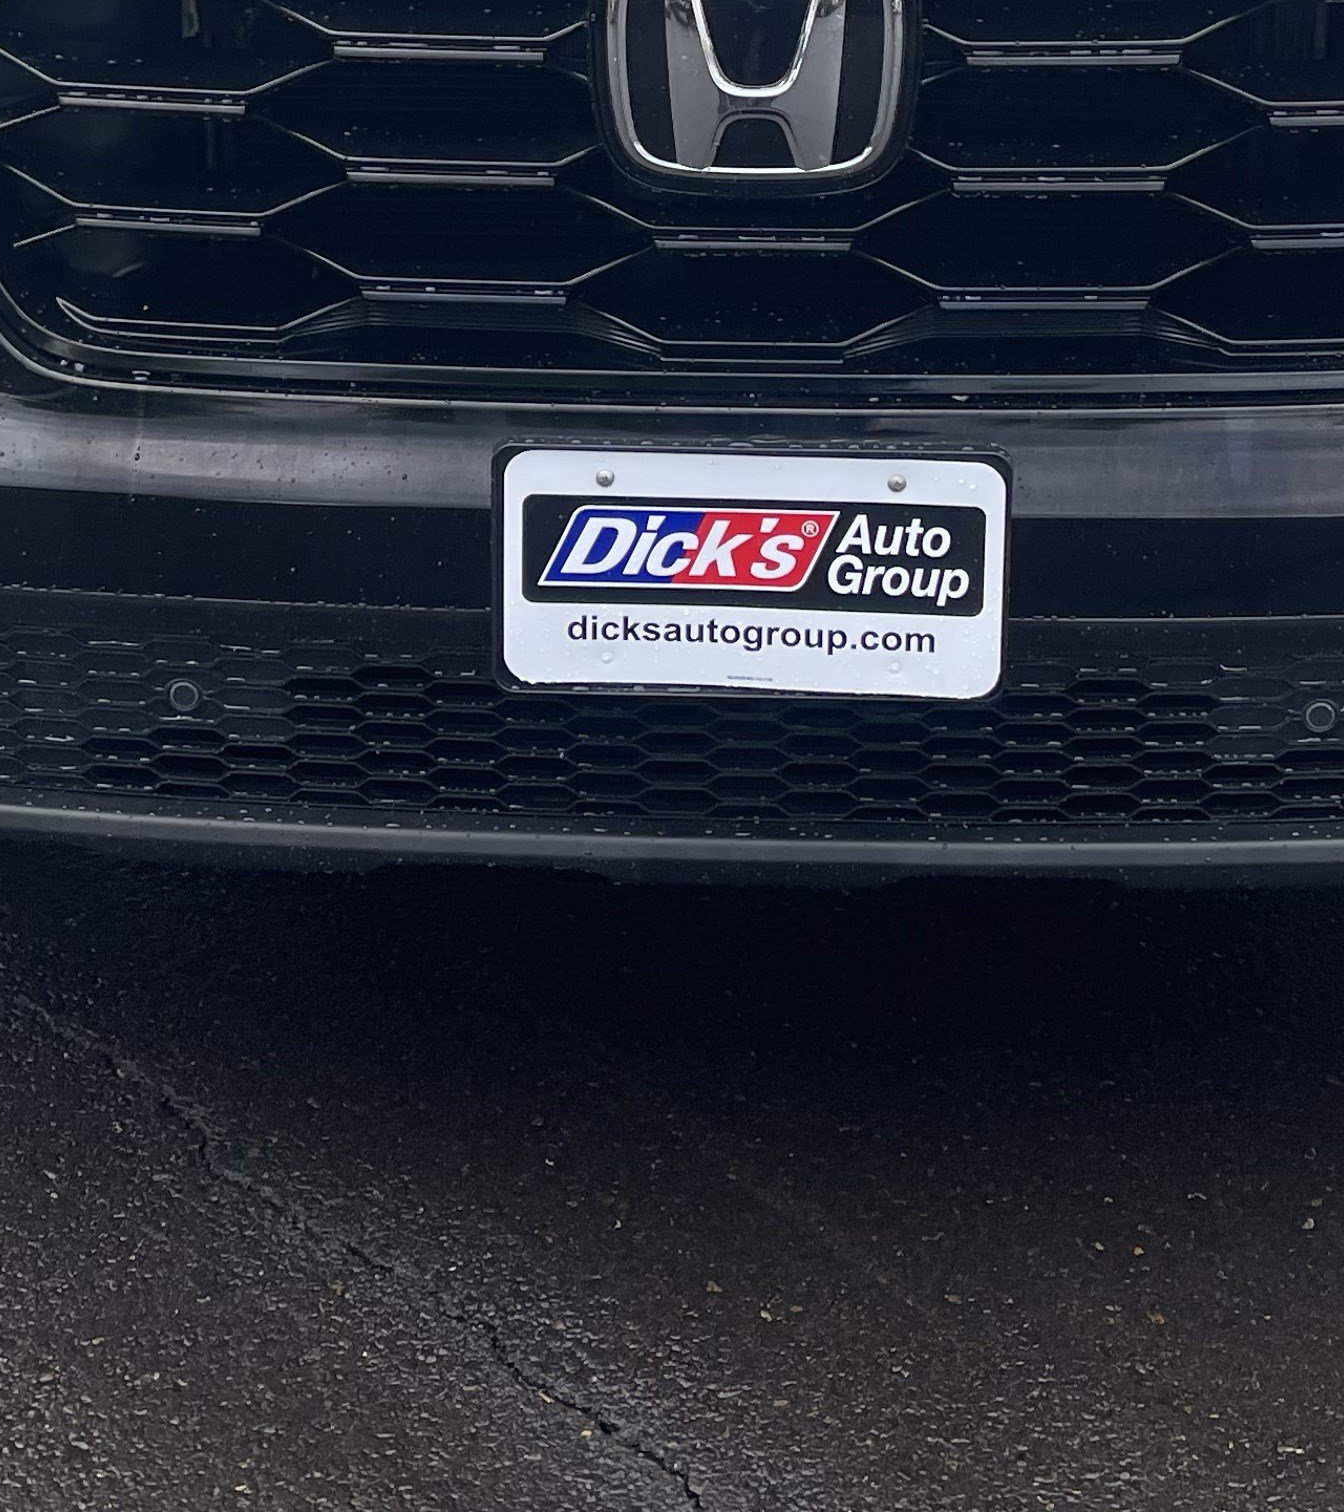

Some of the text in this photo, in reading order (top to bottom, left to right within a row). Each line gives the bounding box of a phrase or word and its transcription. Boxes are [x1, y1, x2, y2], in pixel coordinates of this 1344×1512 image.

[559, 515, 805, 580] Dick's
[835, 513, 952, 559] Auto
[827, 555, 971, 607] Group
[567, 615, 936, 655] dicksautogroup.com
